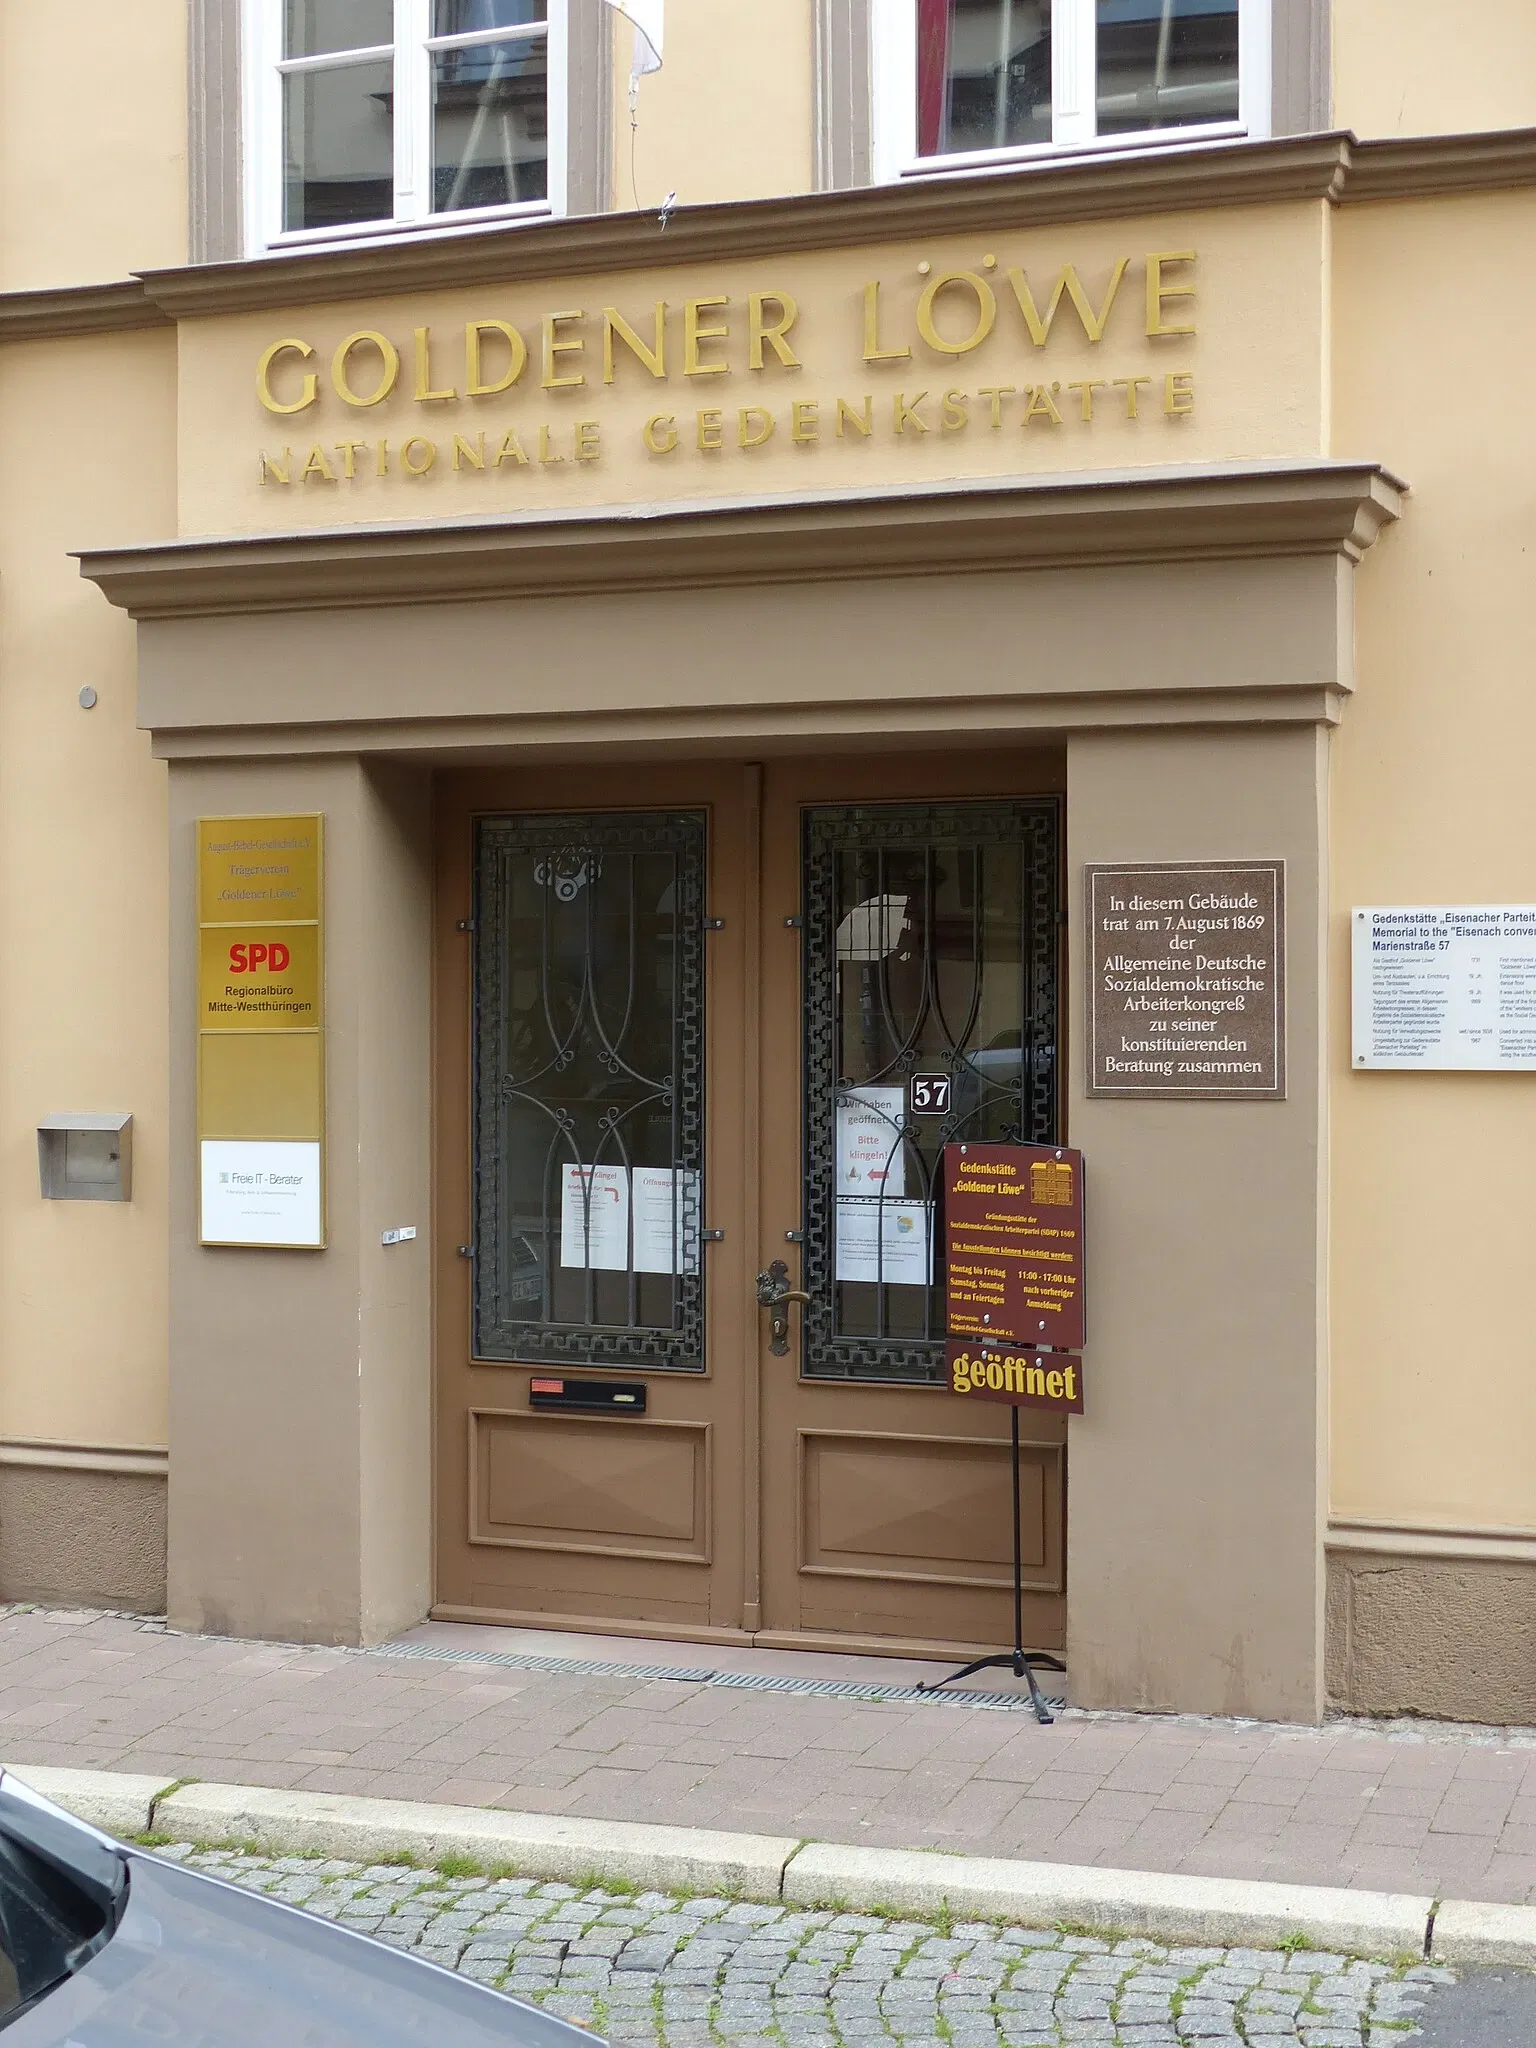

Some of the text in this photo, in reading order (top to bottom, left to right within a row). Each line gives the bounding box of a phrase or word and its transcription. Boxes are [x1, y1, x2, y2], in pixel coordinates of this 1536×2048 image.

[256, 250, 1196, 415] GOLDENER LÖWE
[258, 372, 1193, 485] NATIONALE GEDENKSTÄTTE
[229, 864, 289, 878] Trägerverein
[1110, 893, 1258, 911] In diesem Gebäude
[1102, 918, 1129, 931] trat
[1135, 918, 1159, 931] am
[1232, 915, 1265, 930] 1869
[1372, 912, 1437, 924] Gedenkstätte
[1440, 912, 1500, 924] „Eisenacher
[1372, 926, 1417, 937] Memorial
[1420, 927, 1430, 937] to
[1432, 927, 1448, 937] the
[1451, 926, 1501, 937] "Eisenach
[1169, 935, 1196, 950] der
[1372, 940, 1450, 951] Marienstraße 57
[229, 943, 290, 973] SPD
[1104, 954, 1266, 974] Allgemeine Deutsche
[1104, 975, 1265, 992] Sozialdemokratische
[225, 985, 294, 998] Regionalbüro
[208, 1001, 312, 1014] Mitte-Westthüringen
[1123, 996, 1245, 1014] Arbeiterkongreß
[1149, 1018, 1217, 1032] zu seiner
[1121, 1036, 1247, 1052] konstituierenden
[1105, 1057, 1262, 1076] Beratung zusammen
[915, 1081, 948, 1106] 57
[863, 1099, 892, 1109] haben
[857, 1136, 880, 1145] Bitte
[849, 1150, 888, 1161] klingeln!
[594, 1172, 617, 1180] Klingel
[960, 1161, 1016, 1176] Gedenkstätte
[232, 1172, 254, 1184] Freie
[255, 1173, 263, 1184] IT
[269, 1173, 303, 1185] Berater
[952, 1180, 1025, 1195] „Goldener Löwe“
[1028, 1216, 1037, 1224] der
[952, 1242, 961, 1250] Die
[962, 1243, 1000, 1254] Ausstellungen
[1000, 1245, 1022, 1255] können
[1022, 1248, 1050, 1259] besichtigt
[950, 1264, 972, 1275] Montag
[973, 1266, 983, 1275] bis
[984, 1267, 1006, 1279] Freitag
[1018, 1271, 1038, 1280] 11:00
[1043, 1273, 1062, 1283] 17:00
[1064, 1274, 1076, 1284] Uhr
[950, 1277, 1074, 1299] Samstag, Sonntag nach vorheriger
[950, 1291, 1062, 1312] und an Feiertagen Anmeldung
[953, 1353, 1077, 1400] geöffnet
